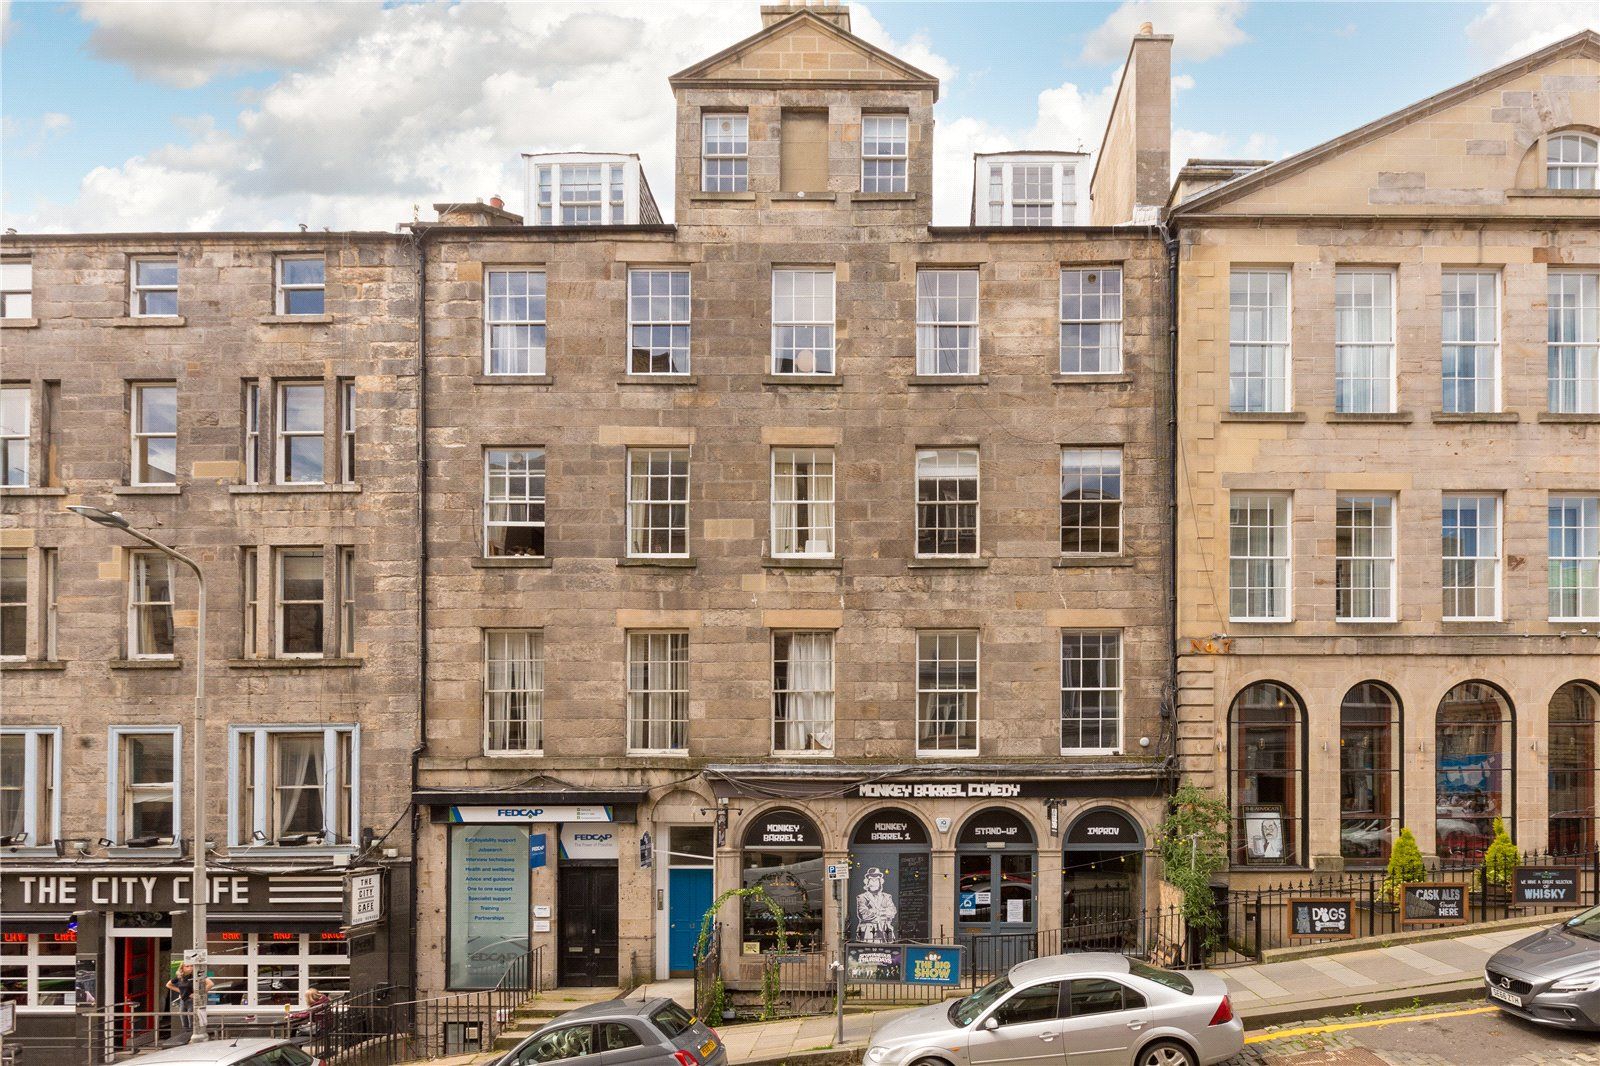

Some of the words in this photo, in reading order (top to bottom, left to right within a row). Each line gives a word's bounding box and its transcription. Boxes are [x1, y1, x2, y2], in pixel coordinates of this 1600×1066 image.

[859, 784, 912, 797] MONKEY
[914, 784, 966, 797] BARREL
[968, 783, 1020, 797] COMEDY
[498, 809, 543, 818] FEDCAP
[767, 824, 800, 832] MONKEY
[874, 823, 907, 831] MONKEY
[974, 826, 1017, 835] STAND-UP
[1087, 827, 1119, 835] IMPROV
[574, 833, 612, 841] FEDCAP
[763, 833, 796, 842] BARREL
[797, 834, 804, 842] 2
[871, 832, 903, 840] BARREL
[361, 878, 372, 886] THE
[19, 877, 76, 904] THE
[92, 877, 157, 904] CITY
[359, 889, 373, 897] CITY
[1415, 889, 1440, 900] CASK
[1441, 889, 1460, 900] ALES
[1524, 888, 1566, 899] WHISKY
[358, 902, 374, 912] CAFE
[1438, 907, 1459, 916] HERE
[915, 960, 933, 968] THE
[934, 961, 950, 969] BIG
[915, 968, 950, 978] SHOW
